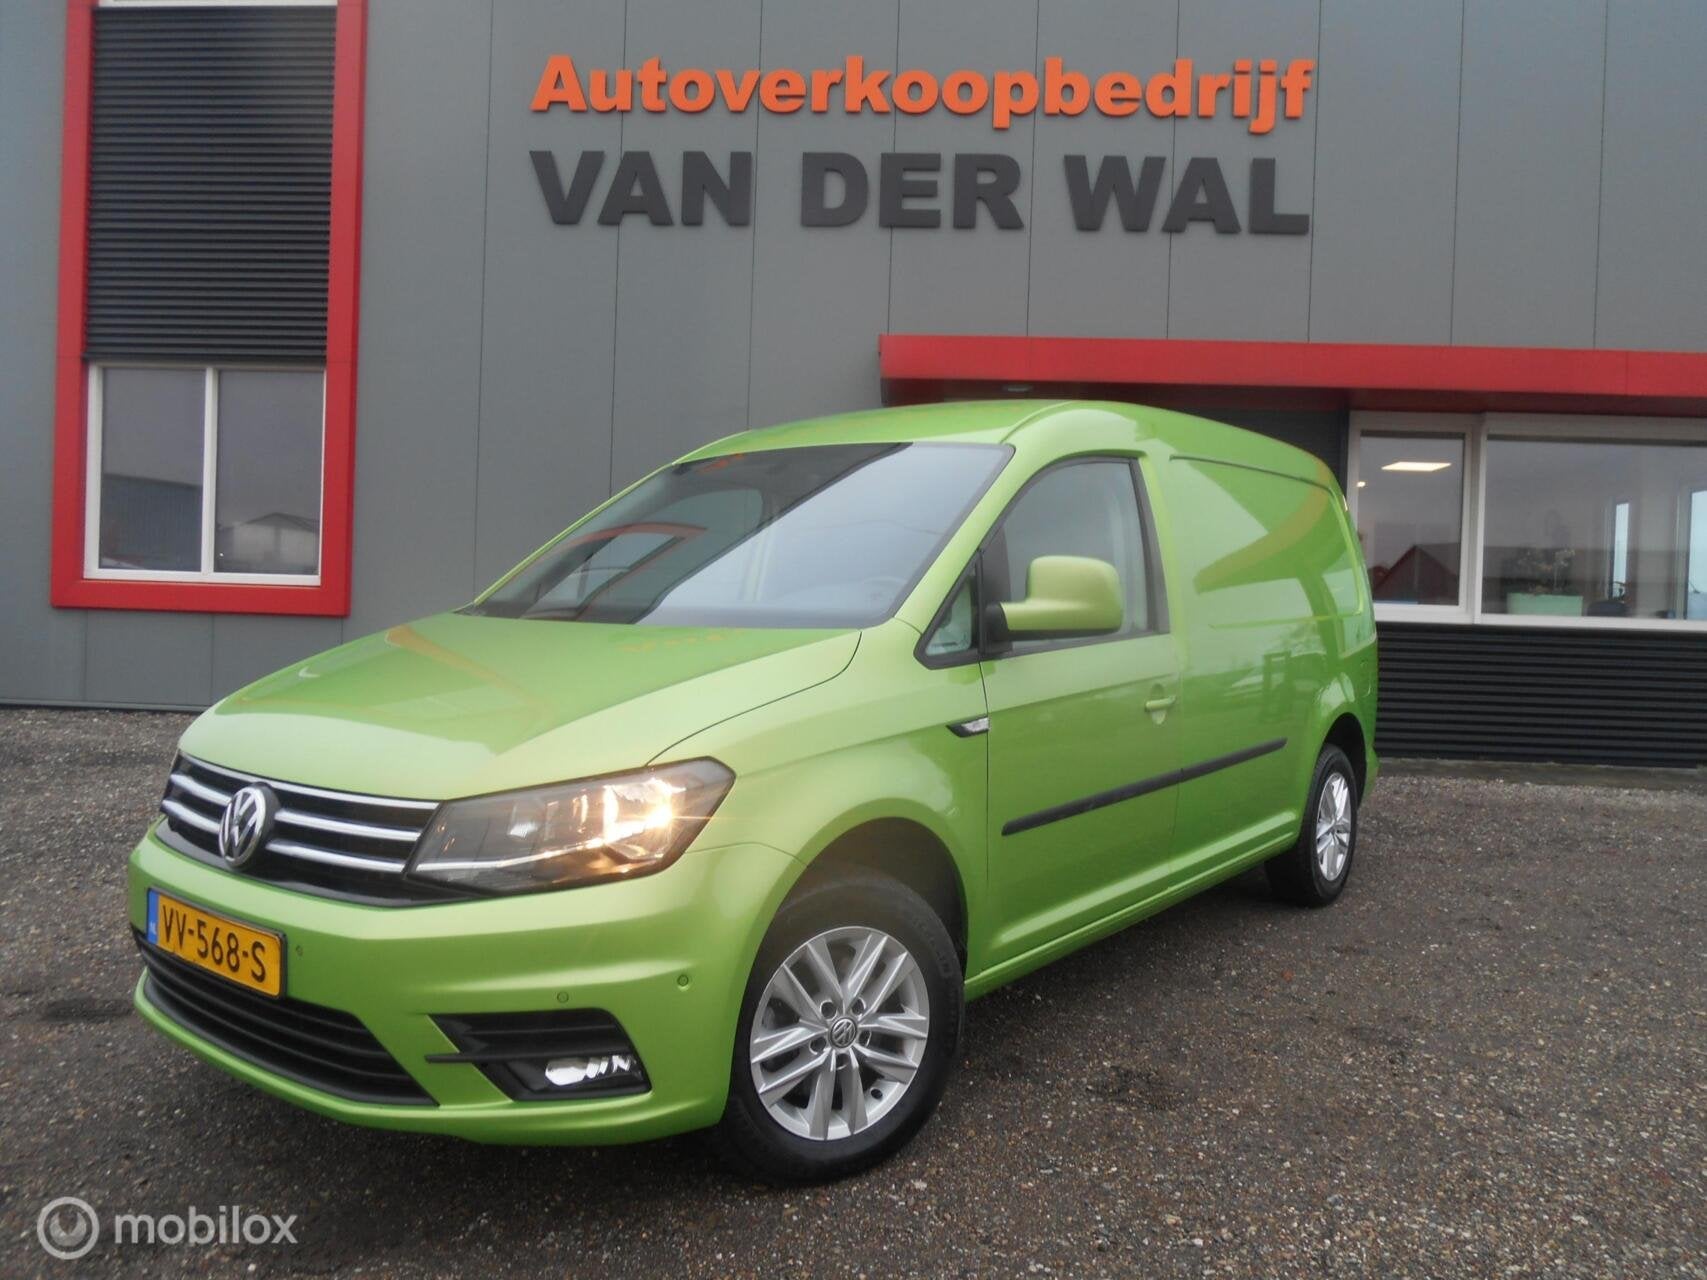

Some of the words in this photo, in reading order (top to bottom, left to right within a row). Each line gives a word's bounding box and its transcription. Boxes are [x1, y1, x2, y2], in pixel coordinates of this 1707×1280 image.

[530, 54, 1315, 134] Autoverkoopbedrijf
[530, 150, 752, 227] VAN
[801, 152, 1023, 231] DER
[1063, 155, 1310, 235] WAL
[163, 904, 266, 983] VV-568-S
